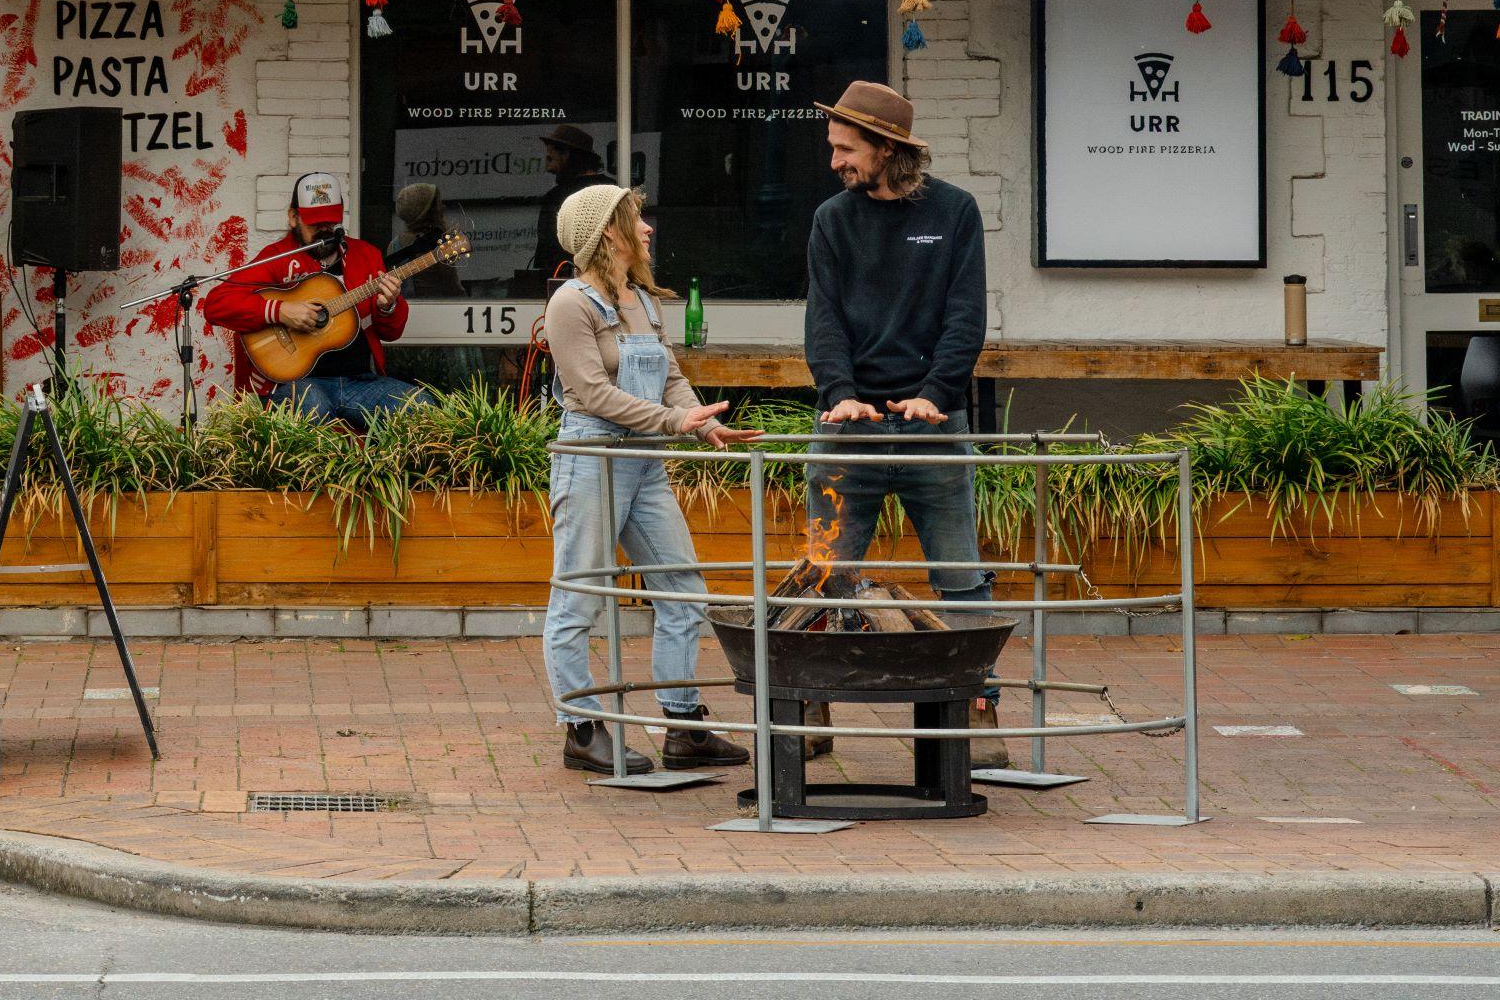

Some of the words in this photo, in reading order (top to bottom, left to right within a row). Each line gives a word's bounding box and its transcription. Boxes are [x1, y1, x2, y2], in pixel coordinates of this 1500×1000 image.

[56, 0, 164, 40] PIZZA
[54, 56, 168, 97] PASTA
[464, 72, 518, 91] URR
[736, 72, 790, 91] URR
[1301, 60, 1374, 103] 115
[408, 108, 454, 118] WOOD
[459, 108, 492, 118] FIRE
[498, 108, 566, 118] PIZZERIA
[680, 108, 727, 118] WOOD
[732, 108, 766, 118] FIRE
[1130, 115, 1180, 132] URR
[1088, 146, 1124, 154] WOOD
[1128, 146, 1156, 154] FIRE
[1160, 146, 1216, 154] PIZZERIA
[1448, 140, 1475, 152] Wed
[464, 306, 516, 335] 115
